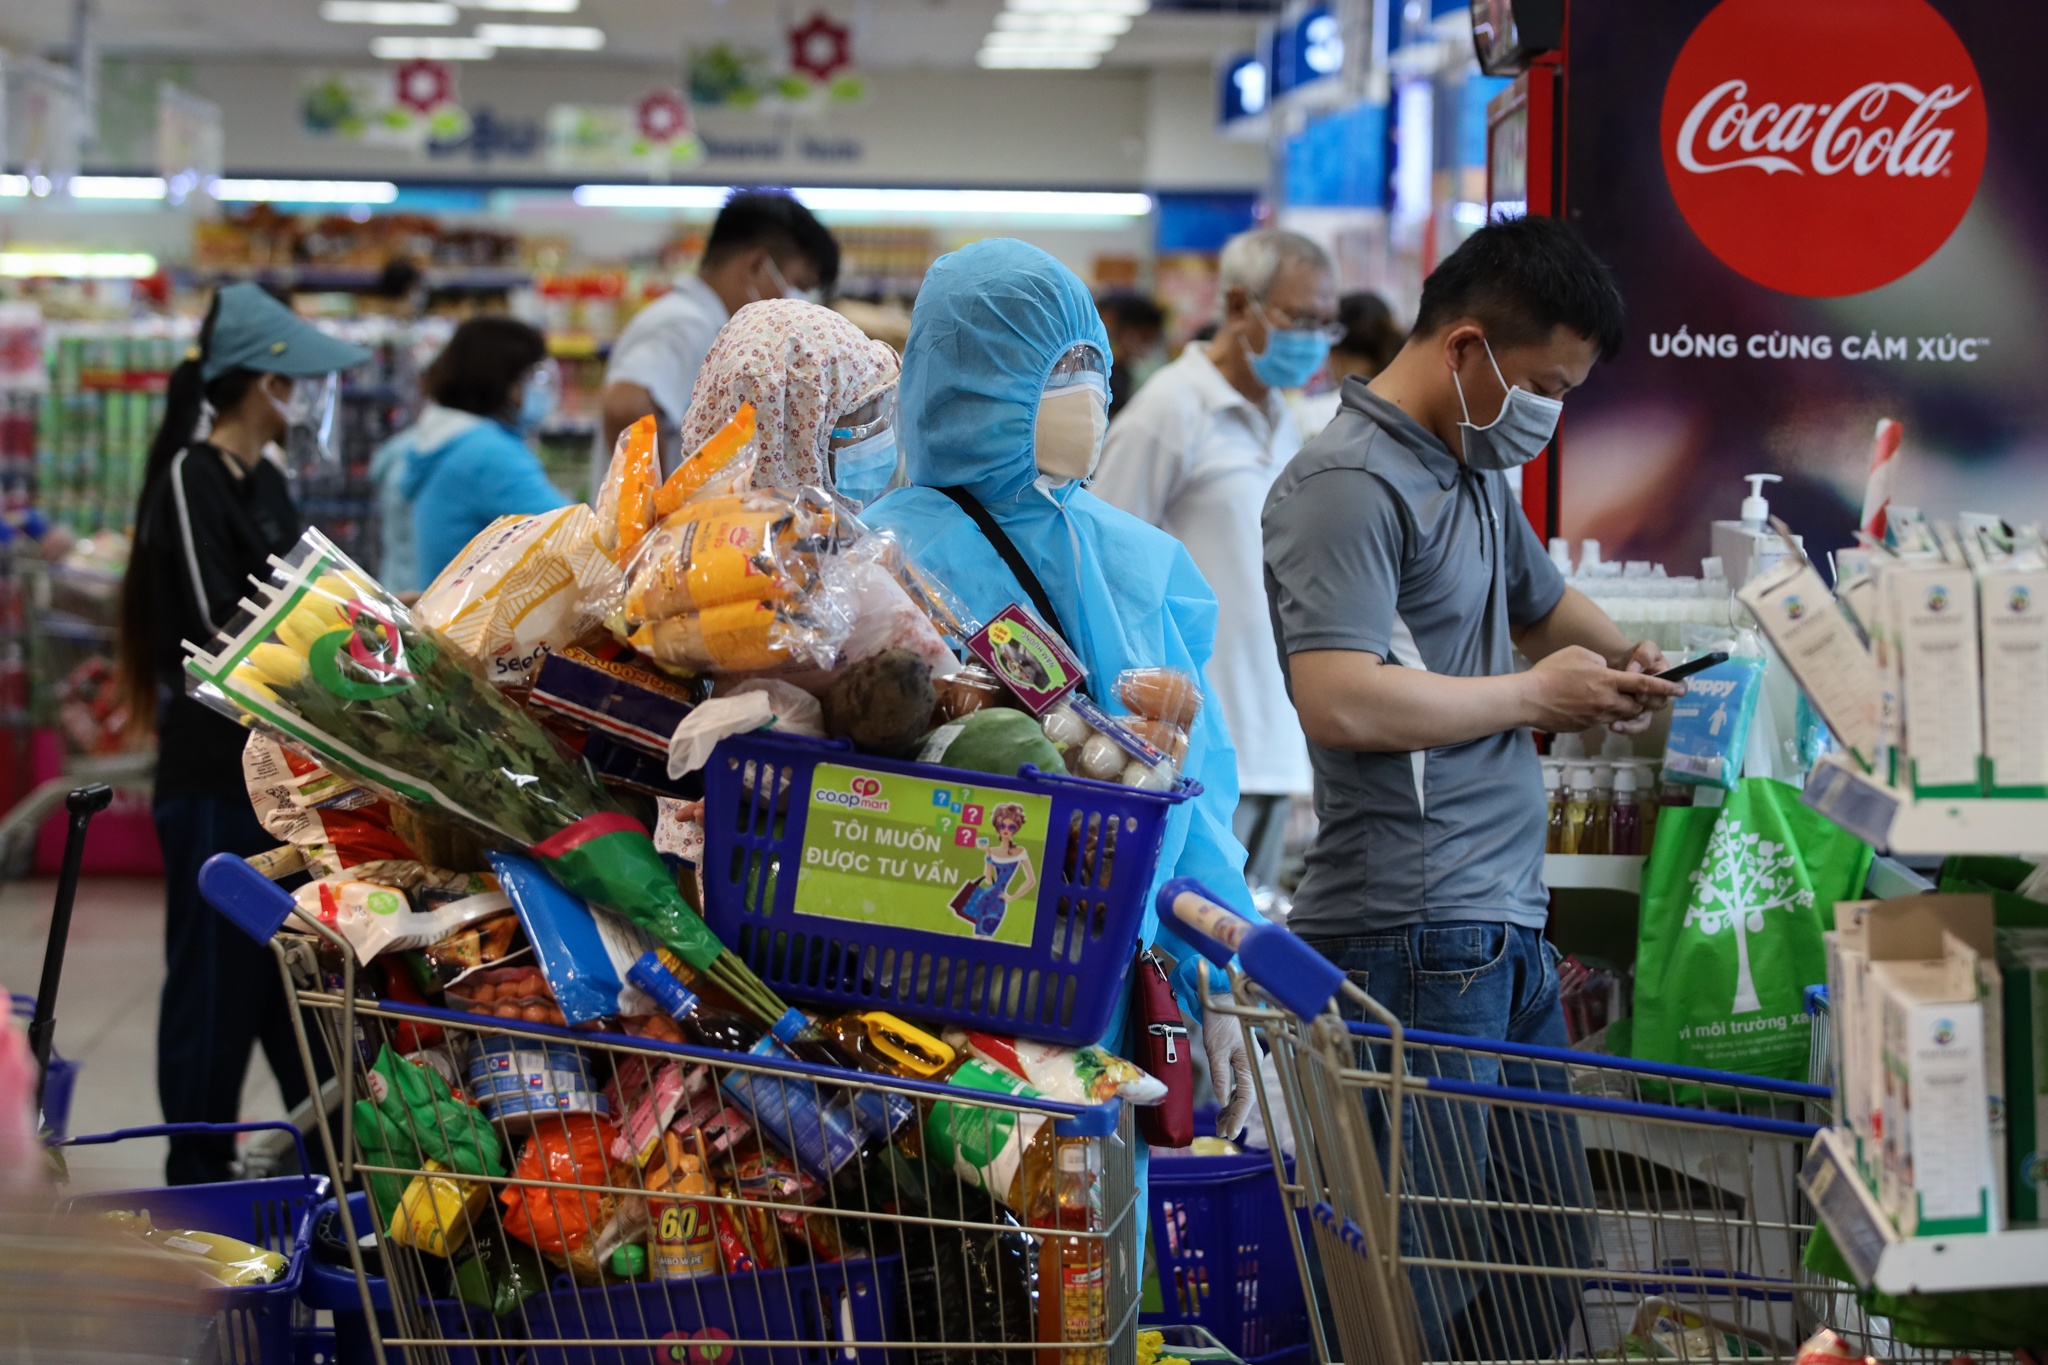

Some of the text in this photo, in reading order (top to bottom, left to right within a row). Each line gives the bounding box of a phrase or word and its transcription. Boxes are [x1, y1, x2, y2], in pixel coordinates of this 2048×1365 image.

[1233, 61, 1266, 114] 1
[1676, 79, 1973, 178] Coca-Cola
[1649, 324, 1738, 358] UỐNG
[1746, 330, 1833, 360] CÙNG
[1841, 330, 1908, 361] CẢM
[496, 641, 552, 675] Select
[832, 819, 941, 853] TÔI MUỐN
[806, 846, 959, 885] ĐƯỢC TƯ VẤN
[1695, 1022, 1726, 1038] môi
[1730, 1015, 1787, 1034] trường
[659, 1204, 699, 1242] 60
